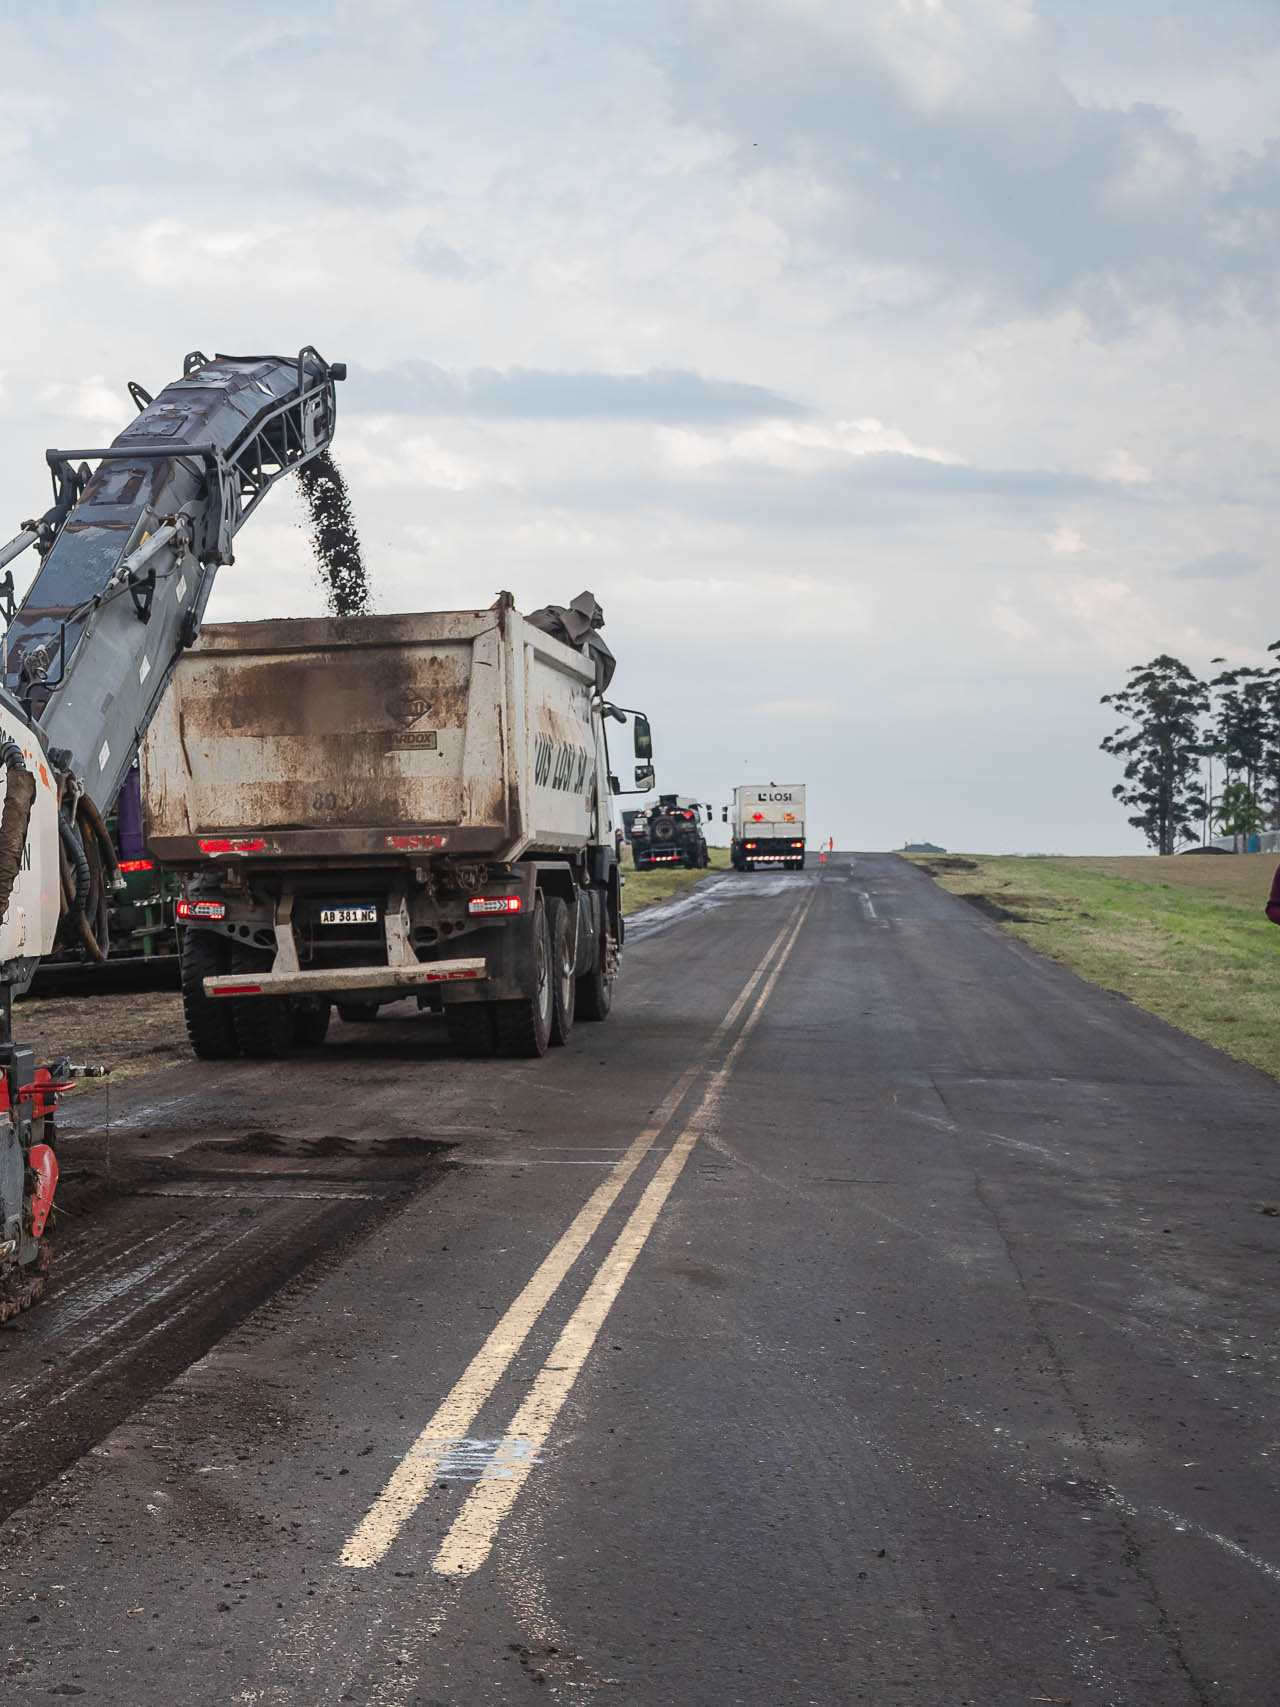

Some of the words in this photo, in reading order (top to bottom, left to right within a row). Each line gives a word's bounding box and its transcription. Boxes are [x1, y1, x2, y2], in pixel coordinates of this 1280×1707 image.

[769, 793, 792, 801] LOSI
[323, 911, 336, 922] AB
[339, 911, 358, 922] 381
